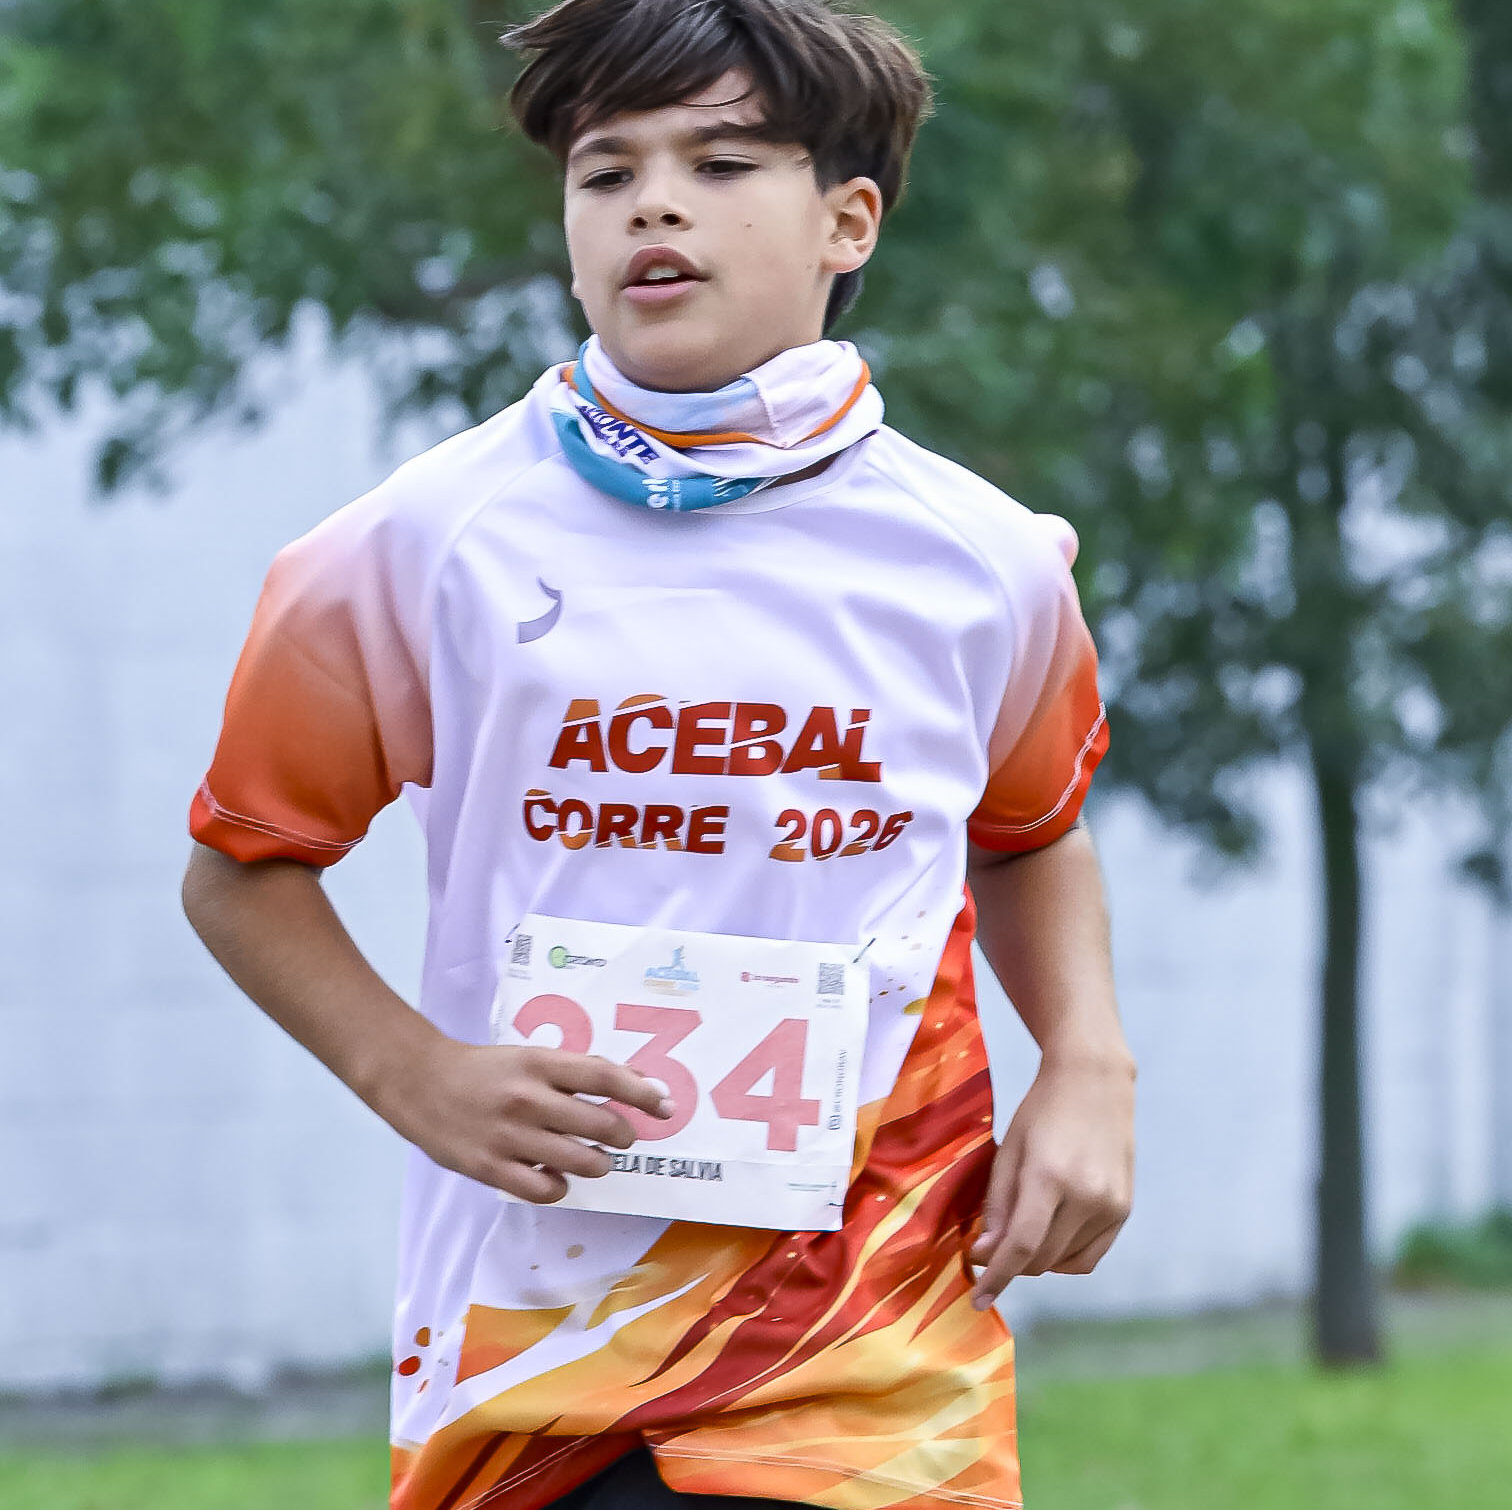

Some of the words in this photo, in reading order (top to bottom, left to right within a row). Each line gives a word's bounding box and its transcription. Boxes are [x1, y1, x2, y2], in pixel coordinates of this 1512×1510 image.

[548, 694, 883, 782] ACEBAL
[523, 789, 731, 855] CORRE
[768, 808, 915, 862] 2026
